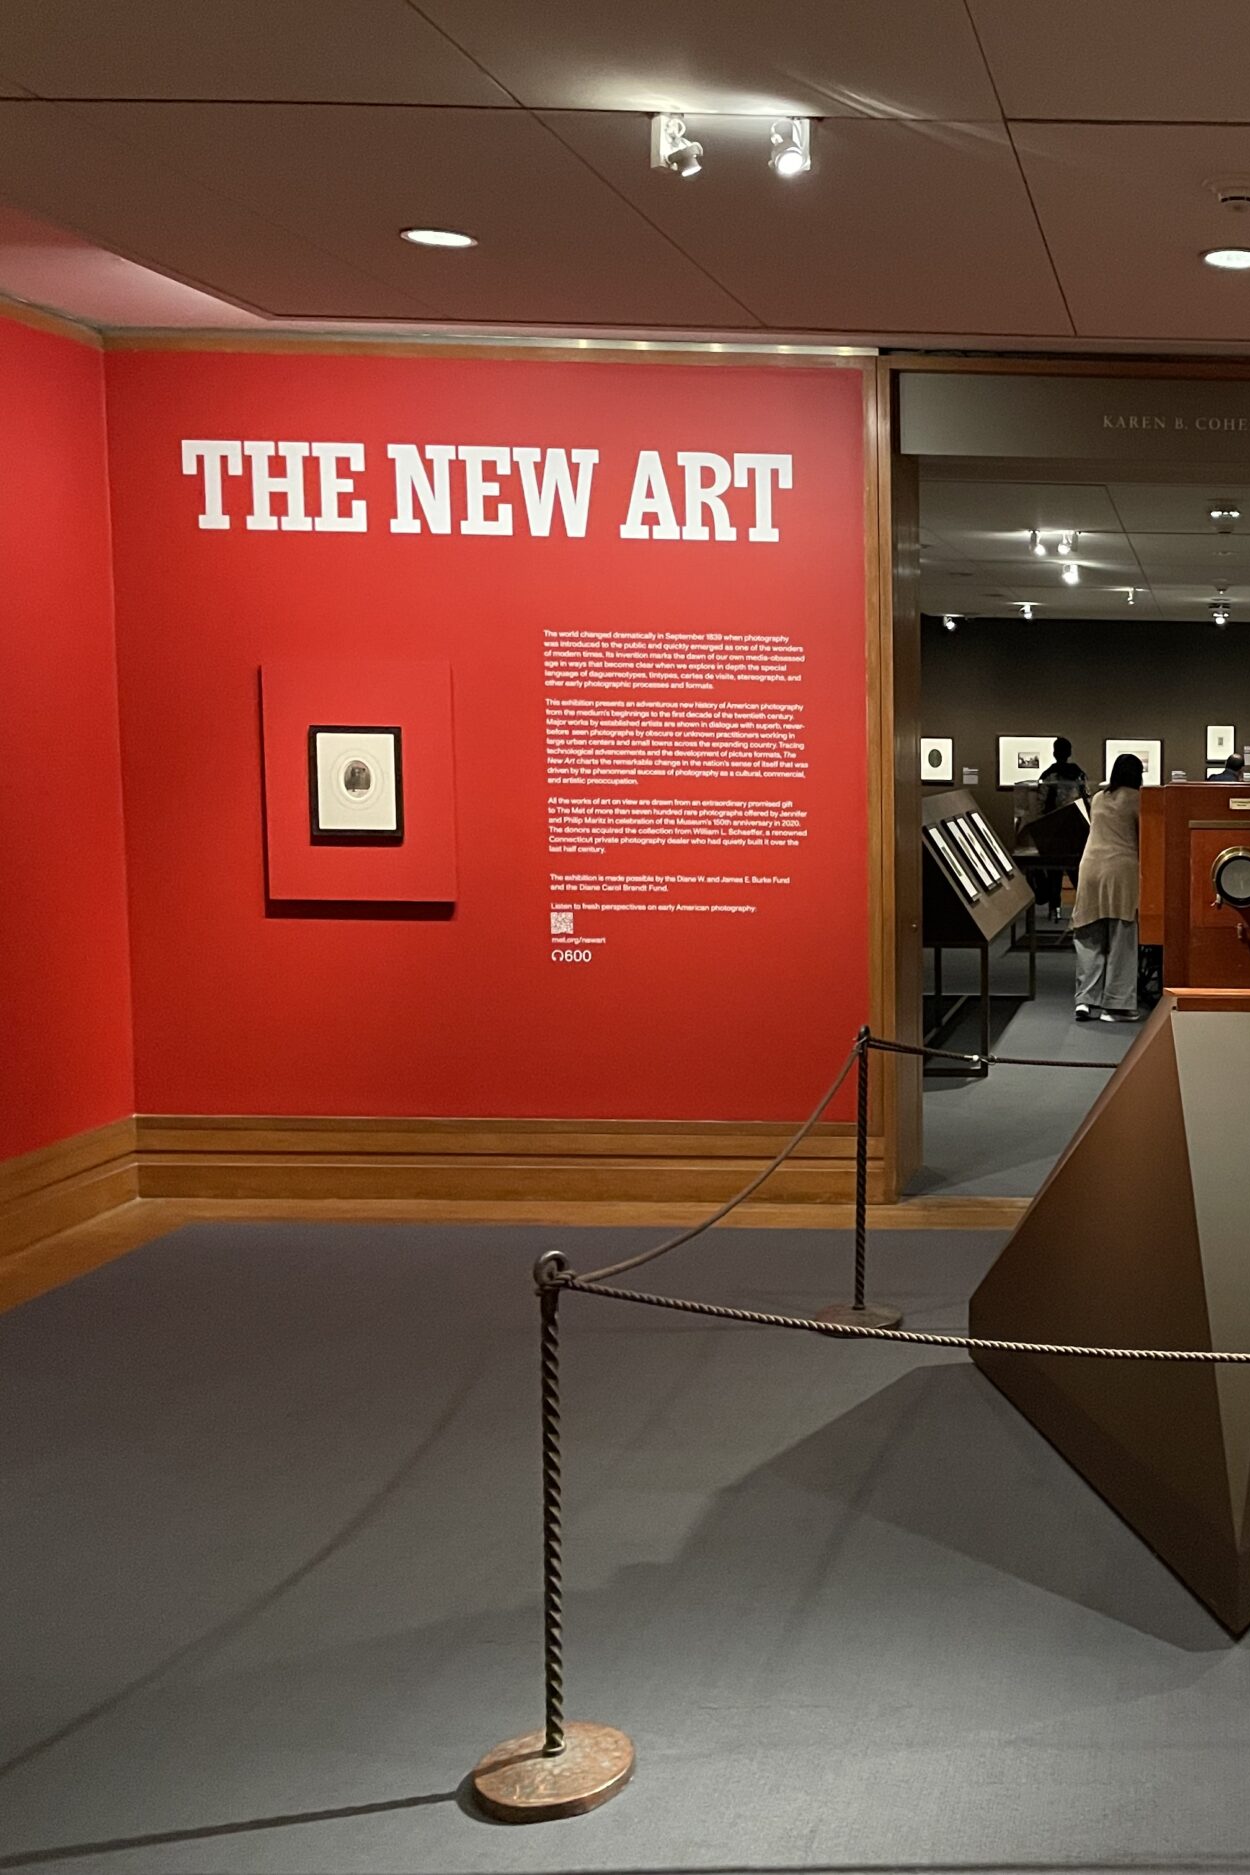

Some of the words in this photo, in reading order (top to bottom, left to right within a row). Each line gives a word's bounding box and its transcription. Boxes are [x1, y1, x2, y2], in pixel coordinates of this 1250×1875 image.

[1103, 415, 1166, 429] KAREN
[1174, 416, 1189, 430] B.
[182, 440, 367, 532] THE
[387, 444, 599, 537] NEW
[619, 450, 793, 542] ART
[544, 629, 557, 637] The
[559, 630, 579, 638] world
[580, 630, 612, 640] changed
[613, 631, 655, 641] dramatically
[666, 632, 704, 642] September
[724, 633, 743, 641] when
[744, 633, 789, 644] photography
[560, 639, 600, 648] introduced
[611, 640, 622, 648] the
[624, 641, 646, 650] public
[648, 641, 662, 649] and
[664, 642, 688, 651] quickly
[691, 642, 723, 652] emerged
[759, 643, 770, 651] the
[773, 644, 803, 652] wonders
[546, 698, 560, 706] This
[562, 698, 594, 706] exhibition
[595, 699, 624, 709] presents
[636, 700, 678, 708] adventurous
[695, 701, 717, 710] history
[727, 701, 759, 709] American
[761, 702, 803, 712] photography
[546, 707, 562, 715] from
[611, 709, 649, 719] beginnings
[659, 709, 670, 717] the
[672, 710, 685, 718] first
[686, 710, 712, 718] decade
[734, 711, 766, 719] twentieth
[548, 796, 557, 804] All
[558, 796, 569, 804] the
[571, 796, 591, 804] works
[601, 797, 610, 805] art
[622, 797, 637, 805] view
[652, 798, 673, 806] drawn
[674, 798, 690, 806] from
[702, 798, 746, 808] extraordinary
[748, 799, 781, 809] promised
[782, 800, 793, 809] gift
[557, 806, 570, 814] The
[572, 806, 585, 814] Met
[653, 807, 682, 815] hundred
[699, 808, 743, 818] photographs
[744, 809, 769, 817] offered
[780, 809, 807, 817] Jennifer
[548, 815, 562, 823] and
[564, 816, 582, 825] Philip
[584, 816, 606, 824] Maritz
[615, 816, 654, 825] celebration
[664, 817, 675, 825] the
[677, 817, 711, 825] Museum's
[733, 818, 772, 828] anniversary
[550, 825, 562, 833] The
[564, 825, 590, 833] donors
[592, 826, 623, 836] acquired
[625, 826, 636, 834] the
[639, 826, 673, 835] collection
[675, 827, 692, 835] from
[693, 827, 719, 835] William
[772, 828, 807, 836] renowned
[549, 835, 593, 843] Connecticut
[595, 836, 619, 845] private
[620, 836, 665, 846] photography
[691, 837, 706, 845] who
[707, 837, 721, 845] had
[723, 837, 745, 847] quietly
[787, 838, 799, 846] the
[549, 844, 562, 852] last
[550, 873, 563, 881] The
[565, 873, 597, 881] exhibition
[605, 874, 624, 882] made
[626, 874, 654, 884] possible
[677, 875, 696, 883] Diane
[707, 875, 720, 883] and
[722, 875, 743, 883] James
[773, 876, 790, 884] Fund
[566, 883, 577, 891] the
[579, 883, 600, 891] Diane
[602, 883, 621, 891] Carol
[551, 902, 572, 910] Listen
[582, 902, 600, 910] fresh
[601, 902, 646, 912] perspectives
[658, 903, 674, 912] early
[677, 903, 709, 911] American
[564, 949, 592, 962] 600
